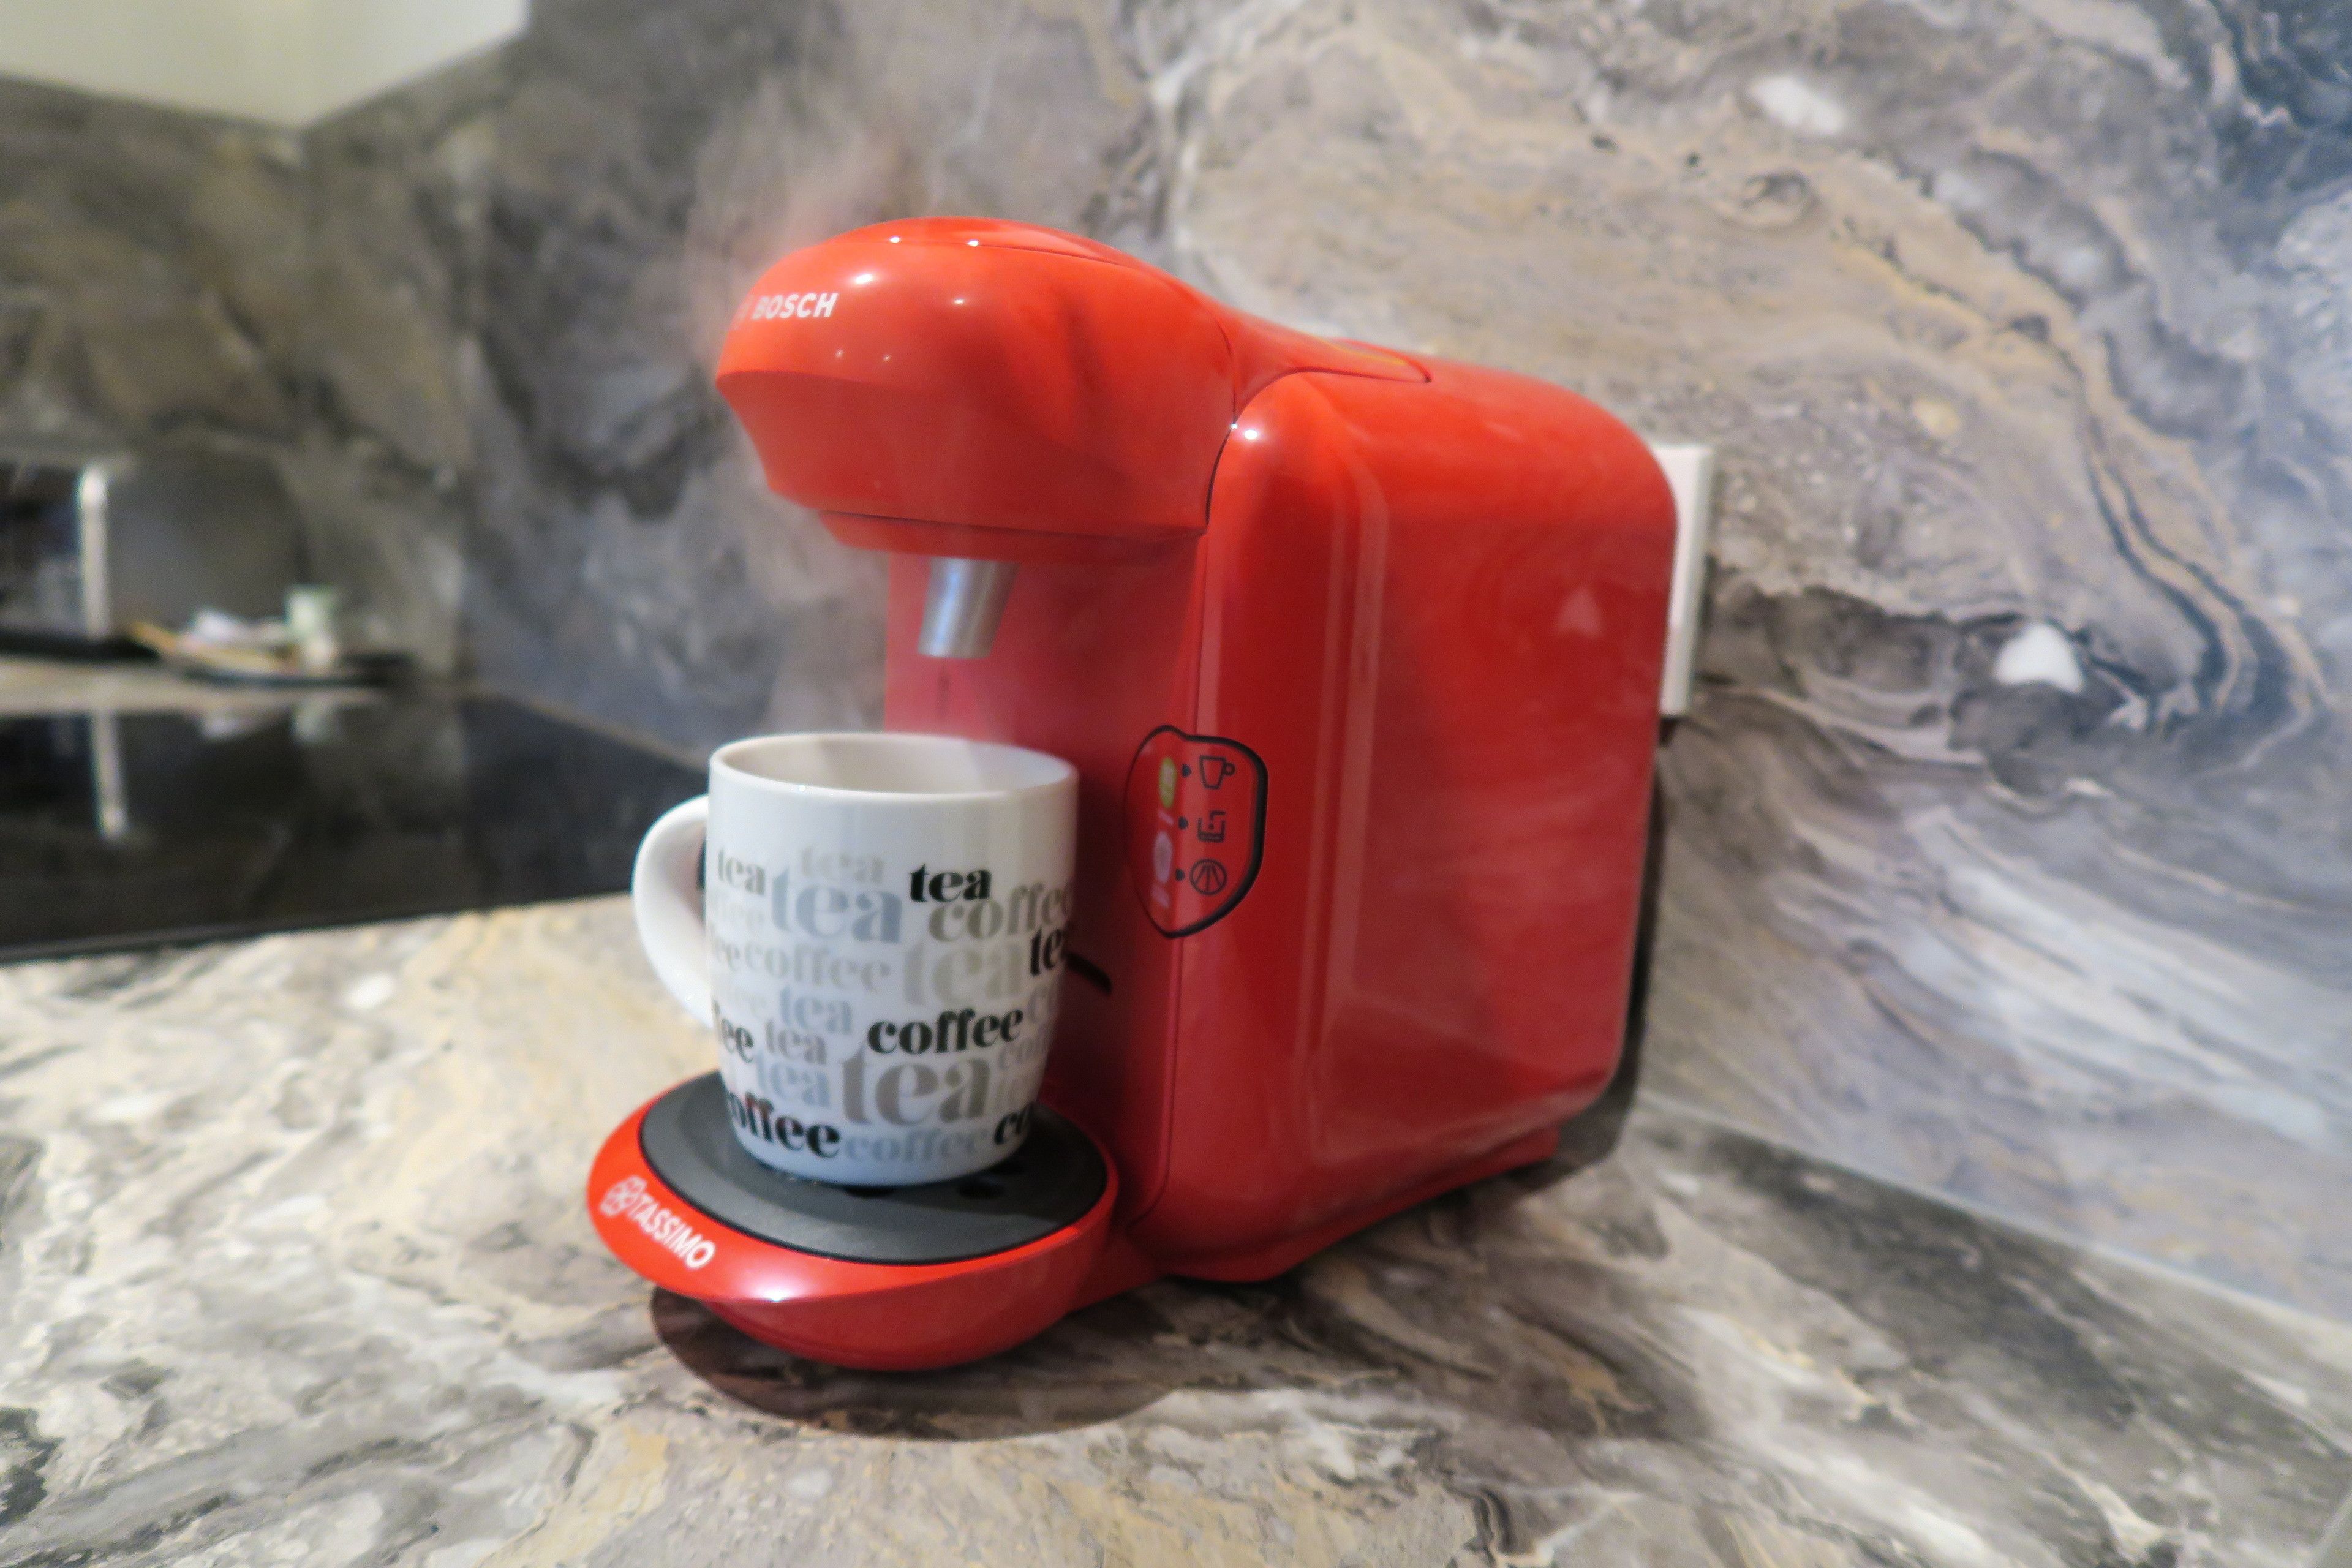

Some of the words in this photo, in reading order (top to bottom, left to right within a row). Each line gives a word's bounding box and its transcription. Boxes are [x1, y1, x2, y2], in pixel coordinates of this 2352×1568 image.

[750, 292, 839, 320] BOSCH
[717, 847, 765, 896] tea
[800, 845, 886, 884] tea
[909, 863, 992, 903] tea
[771, 864, 902, 945] tea
[742, 940, 891, 995] coffee
[902, 939, 1024, 1007] tea
[779, 985, 853, 1035] tea
[867, 1008, 1024, 1055] coffee
[765, 1017, 827, 1066] tea
[755, 1049, 831, 1109] tea
[840, 1041, 990, 1127] tea
[844, 1126, 989, 1163] coffee
[628, 1192, 716, 1270] TASSIMO
